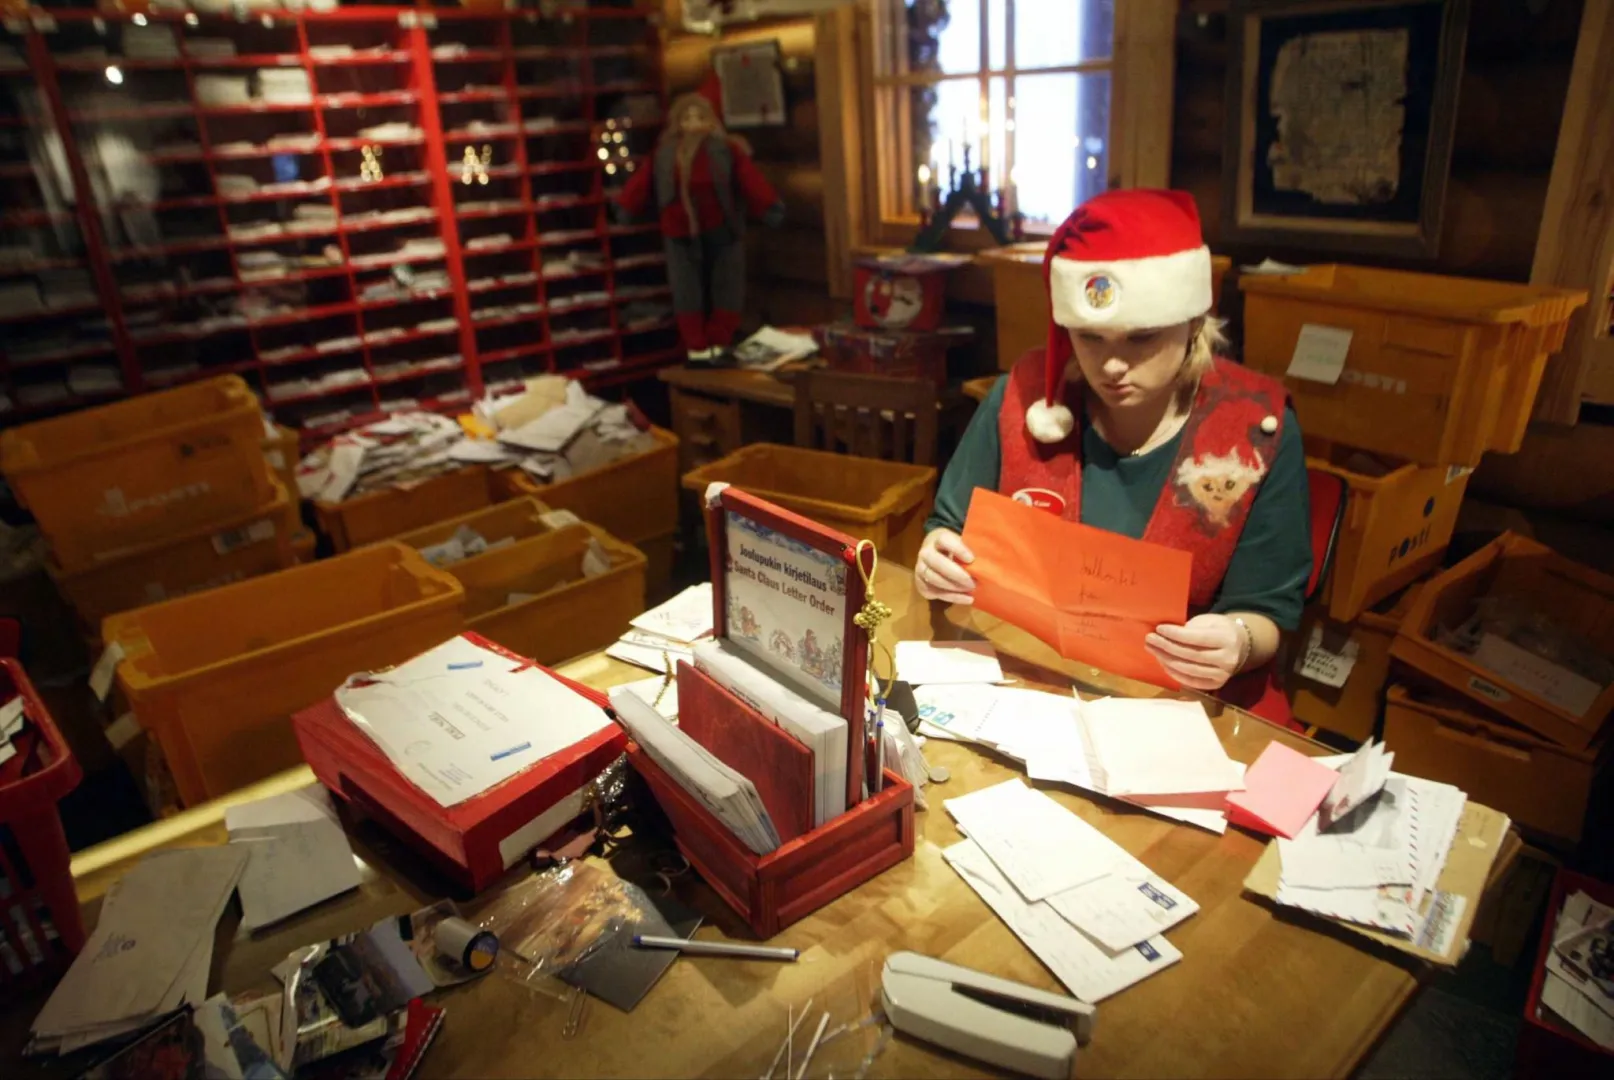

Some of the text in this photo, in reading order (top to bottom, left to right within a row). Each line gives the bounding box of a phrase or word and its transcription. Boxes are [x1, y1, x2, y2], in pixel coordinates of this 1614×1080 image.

[1341, 370, 1407, 394] OSTI
[734, 560, 756, 580] Santa
[757, 571, 780, 591] Claus
[782, 582, 807, 604] Letter
[809, 594, 836, 616] Order
[740, 543, 782, 573] Joulupukin
[784, 562, 827, 592] kirjetilaus
